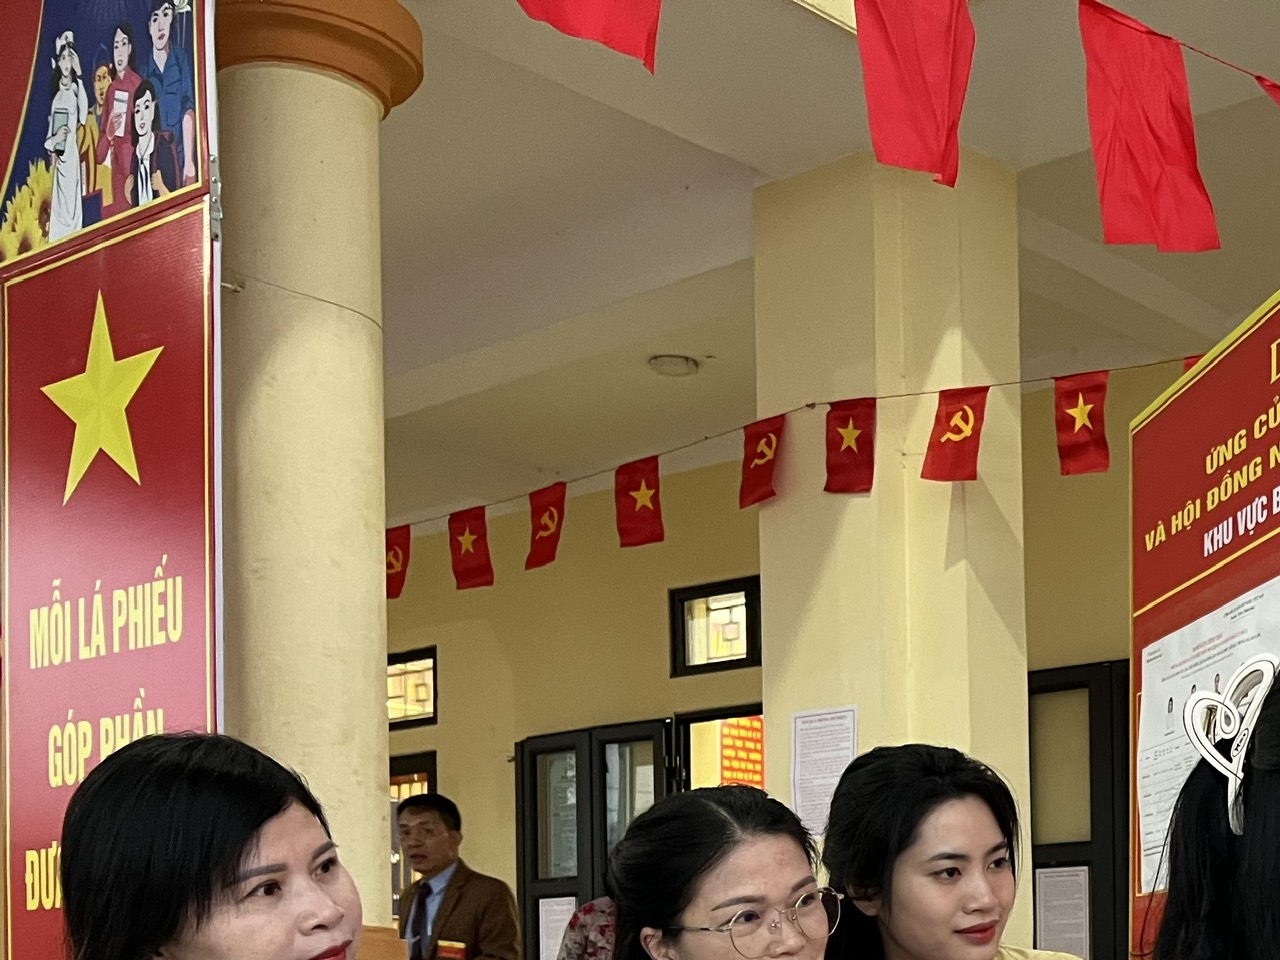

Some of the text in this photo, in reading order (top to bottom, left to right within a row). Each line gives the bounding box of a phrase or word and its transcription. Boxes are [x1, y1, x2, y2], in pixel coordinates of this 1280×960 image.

[1205, 429, 1247, 476] ỨNG
[1145, 520, 1167, 552] VÀ
[1171, 497, 1201, 536] HỘI
[1206, 455, 1263, 513] ĐỒNG
[1203, 517, 1233, 558] KHU
[1237, 495, 1268, 537] VỰC
[29, 554, 183, 670] MỖI LÁ PHIẾU
[48, 709, 92, 788] GÓP
